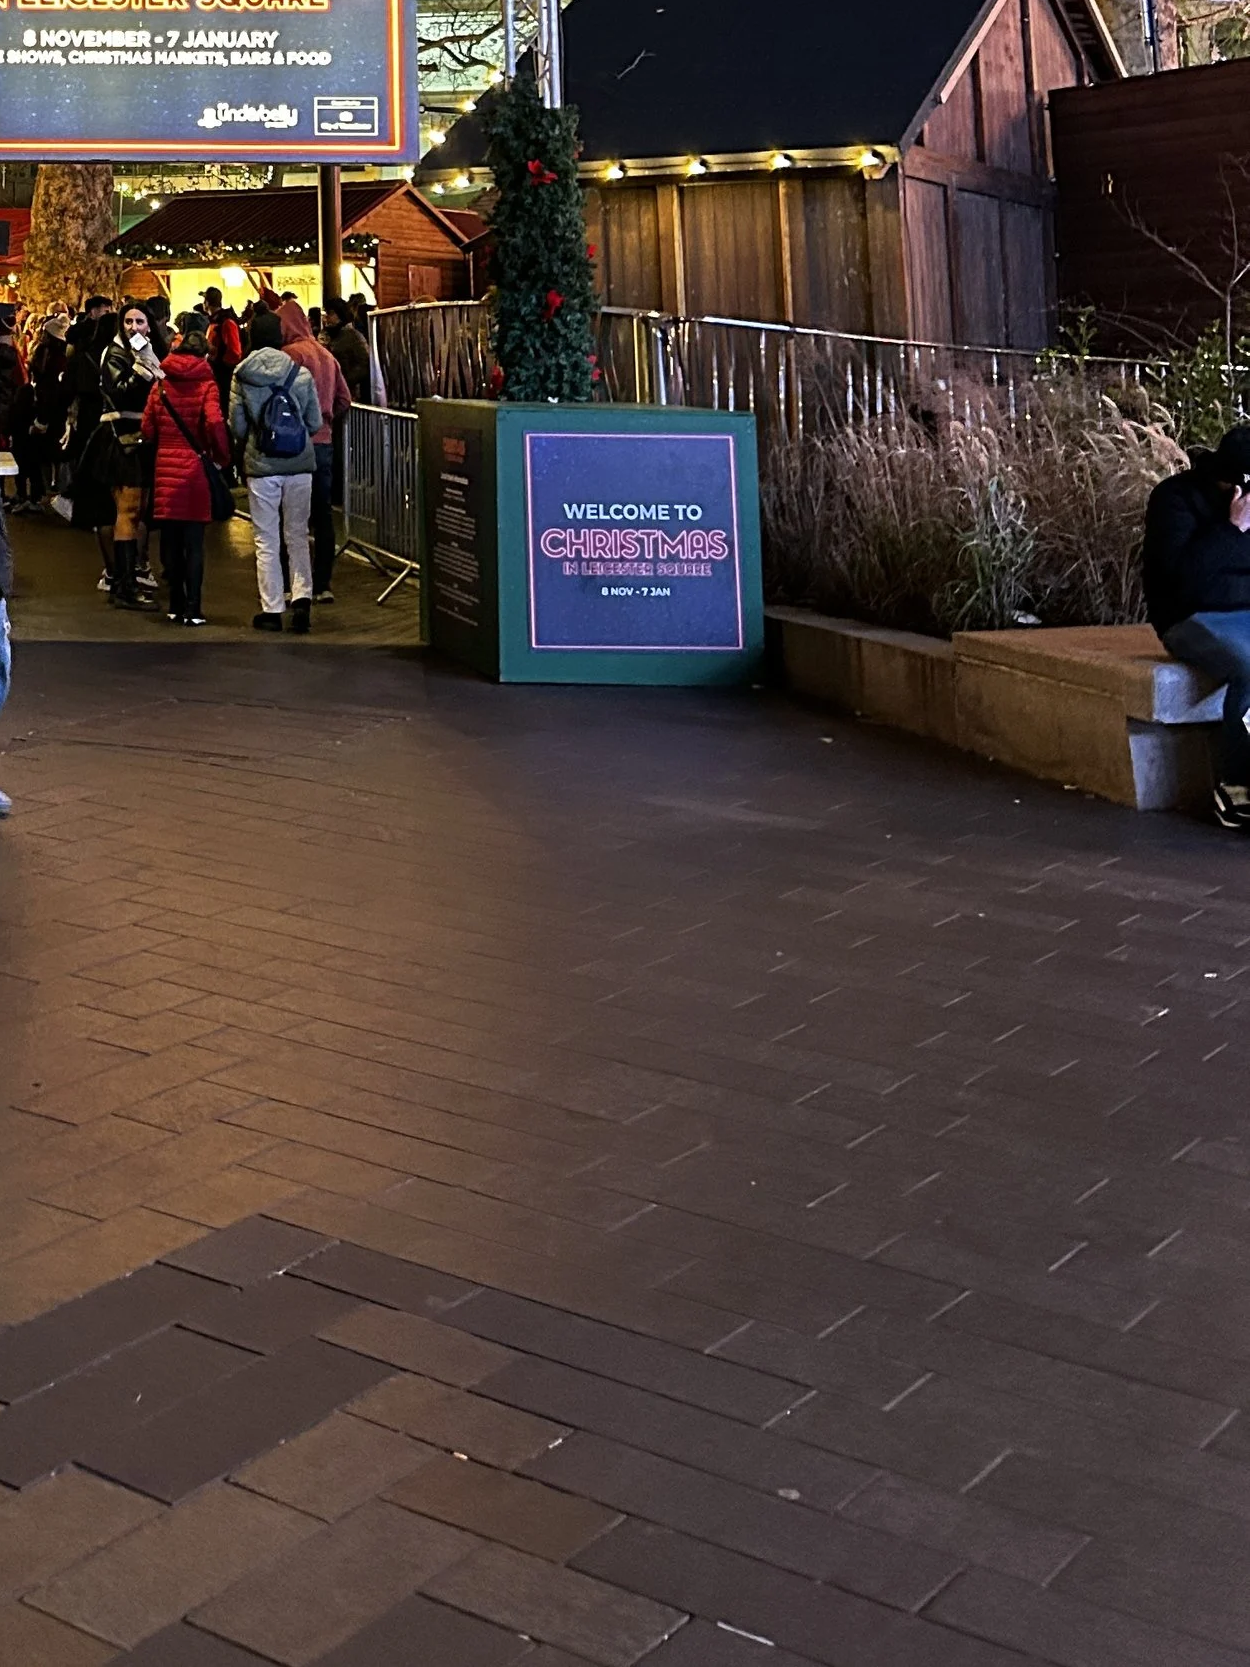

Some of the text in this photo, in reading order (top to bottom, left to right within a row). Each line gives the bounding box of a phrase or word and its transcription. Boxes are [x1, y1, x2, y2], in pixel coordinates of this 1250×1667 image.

[22, 29, 37, 47] 8
[40, 29, 152, 48] NOVEMBER
[166, 30, 180, 48] 7
[182, 30, 280, 49] JANUARY
[6, 49, 67, 66] SHOWS,
[68, 50, 153, 65] CHRISTMAS
[155, 50, 229, 67] MARKETS,
[230, 51, 272, 65] BARS
[273, 51, 285, 65] &
[286, 51, 332, 66] FOOD
[563, 503, 703, 521] WELCOME TO
[540, 528, 729, 560] CHRISTMAS
[562, 561, 713, 577] IN LEICESTER SQUARE
[601, 587, 608, 596] 8
[610, 587, 634, 596] NOV
[641, 587, 648, 596] 7
[650, 587, 671, 596] JAN
